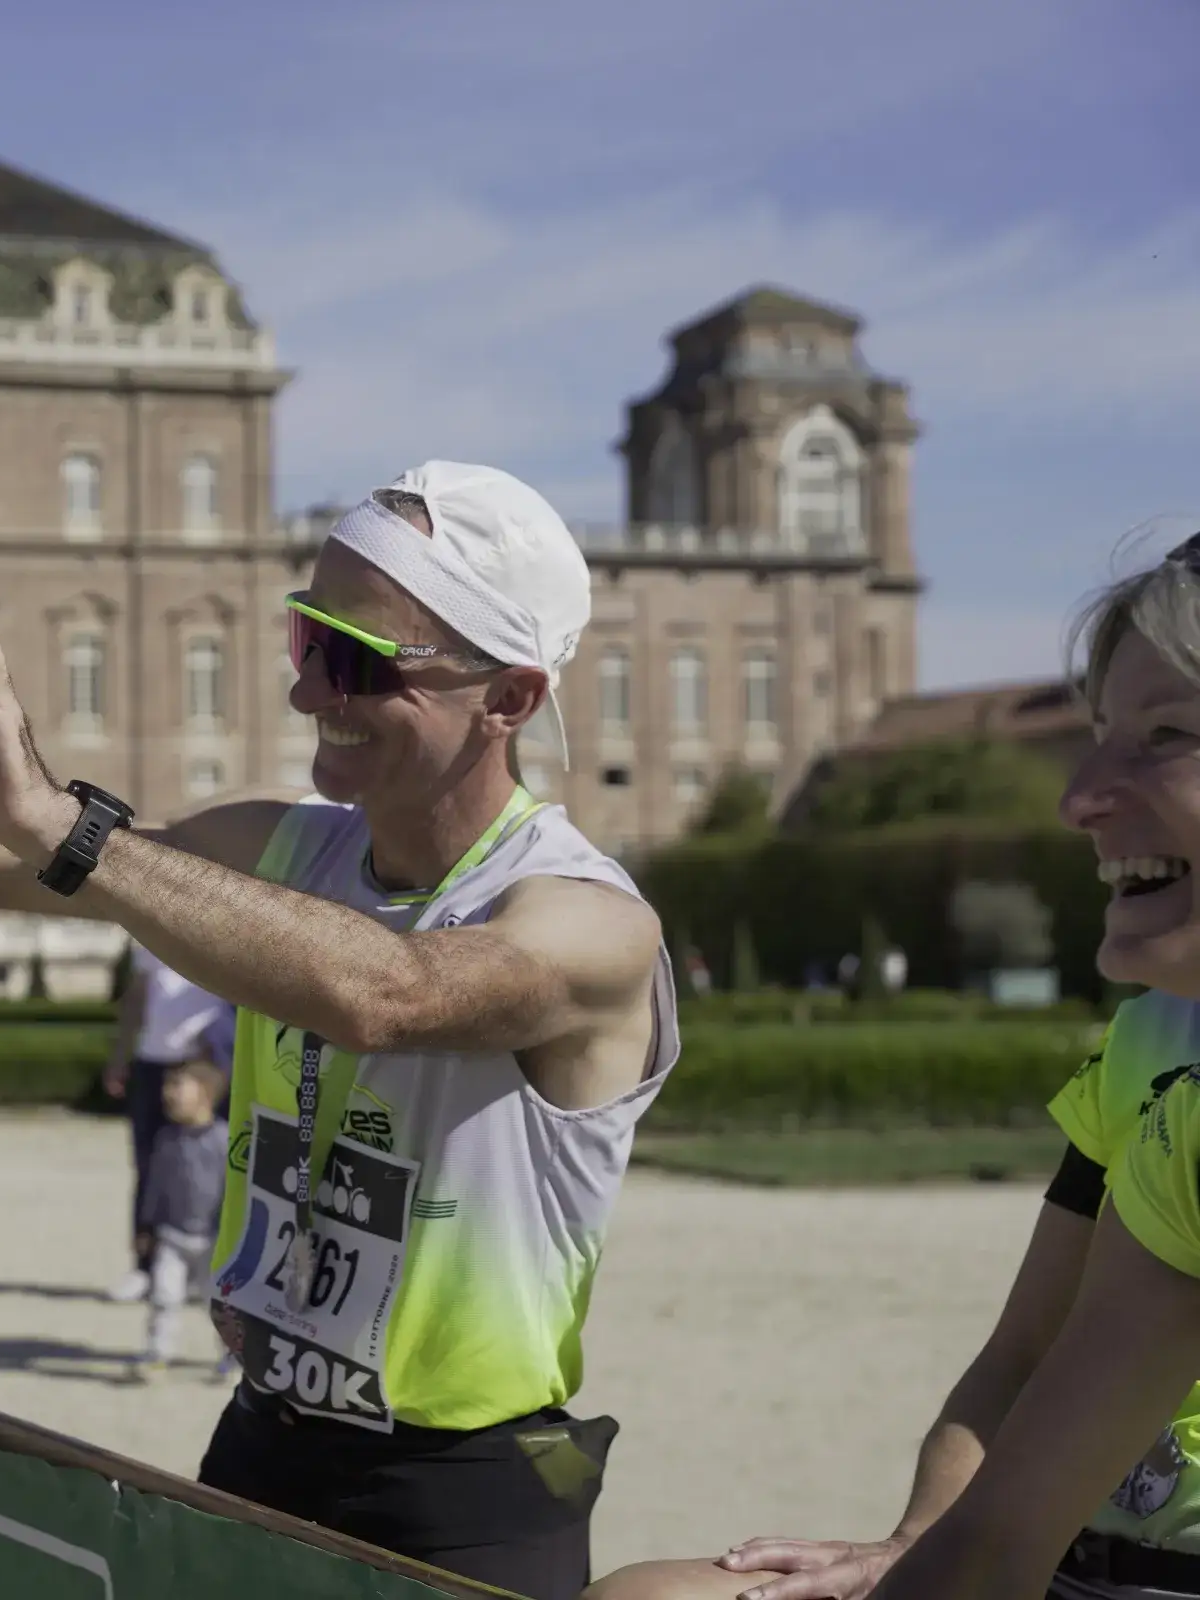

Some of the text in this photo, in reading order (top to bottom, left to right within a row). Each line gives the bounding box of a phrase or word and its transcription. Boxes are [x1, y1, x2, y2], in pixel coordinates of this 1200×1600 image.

[400, 647, 437, 656] OAKLEY
[370, 1286, 392, 1341] OTTOBRE
[263, 1334, 382, 1413] 30K
